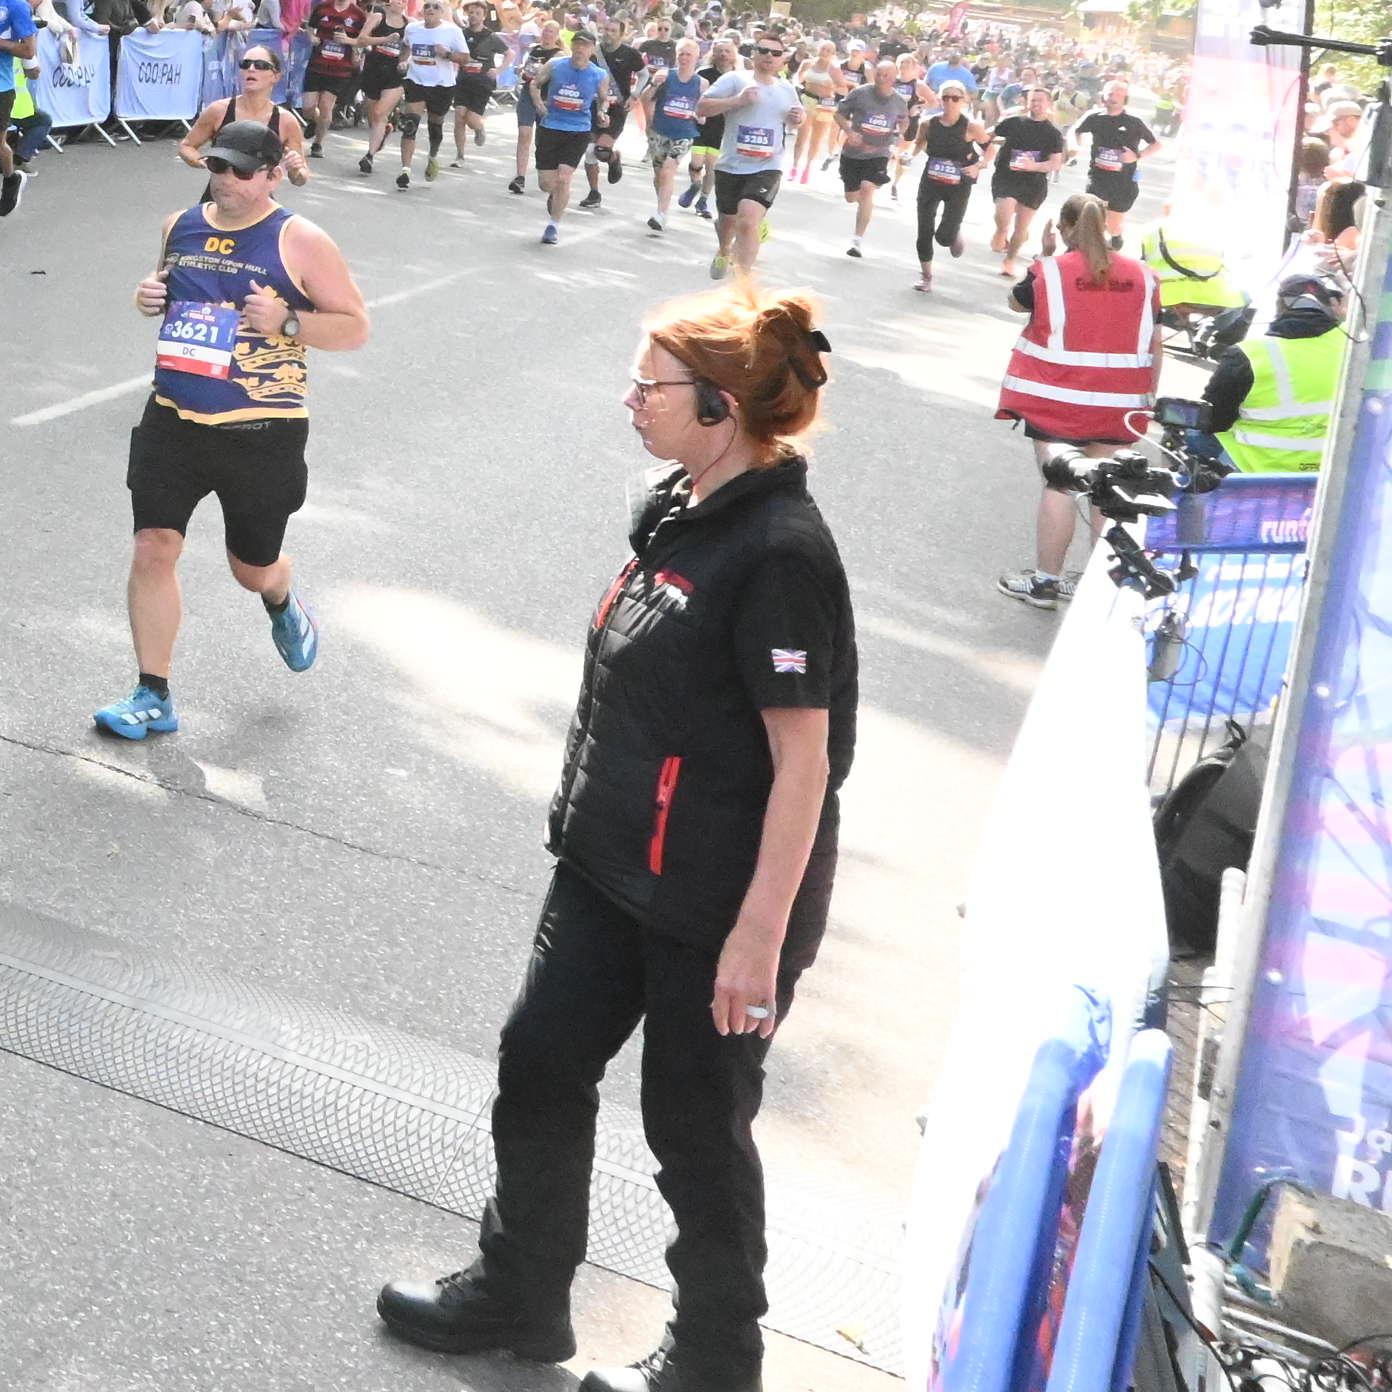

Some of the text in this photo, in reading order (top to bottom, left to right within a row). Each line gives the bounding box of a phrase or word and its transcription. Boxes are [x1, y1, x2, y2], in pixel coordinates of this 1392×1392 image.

[204, 236, 236, 255] DC
[171, 320, 219, 344] 3621
[182, 346, 196, 357] DC
